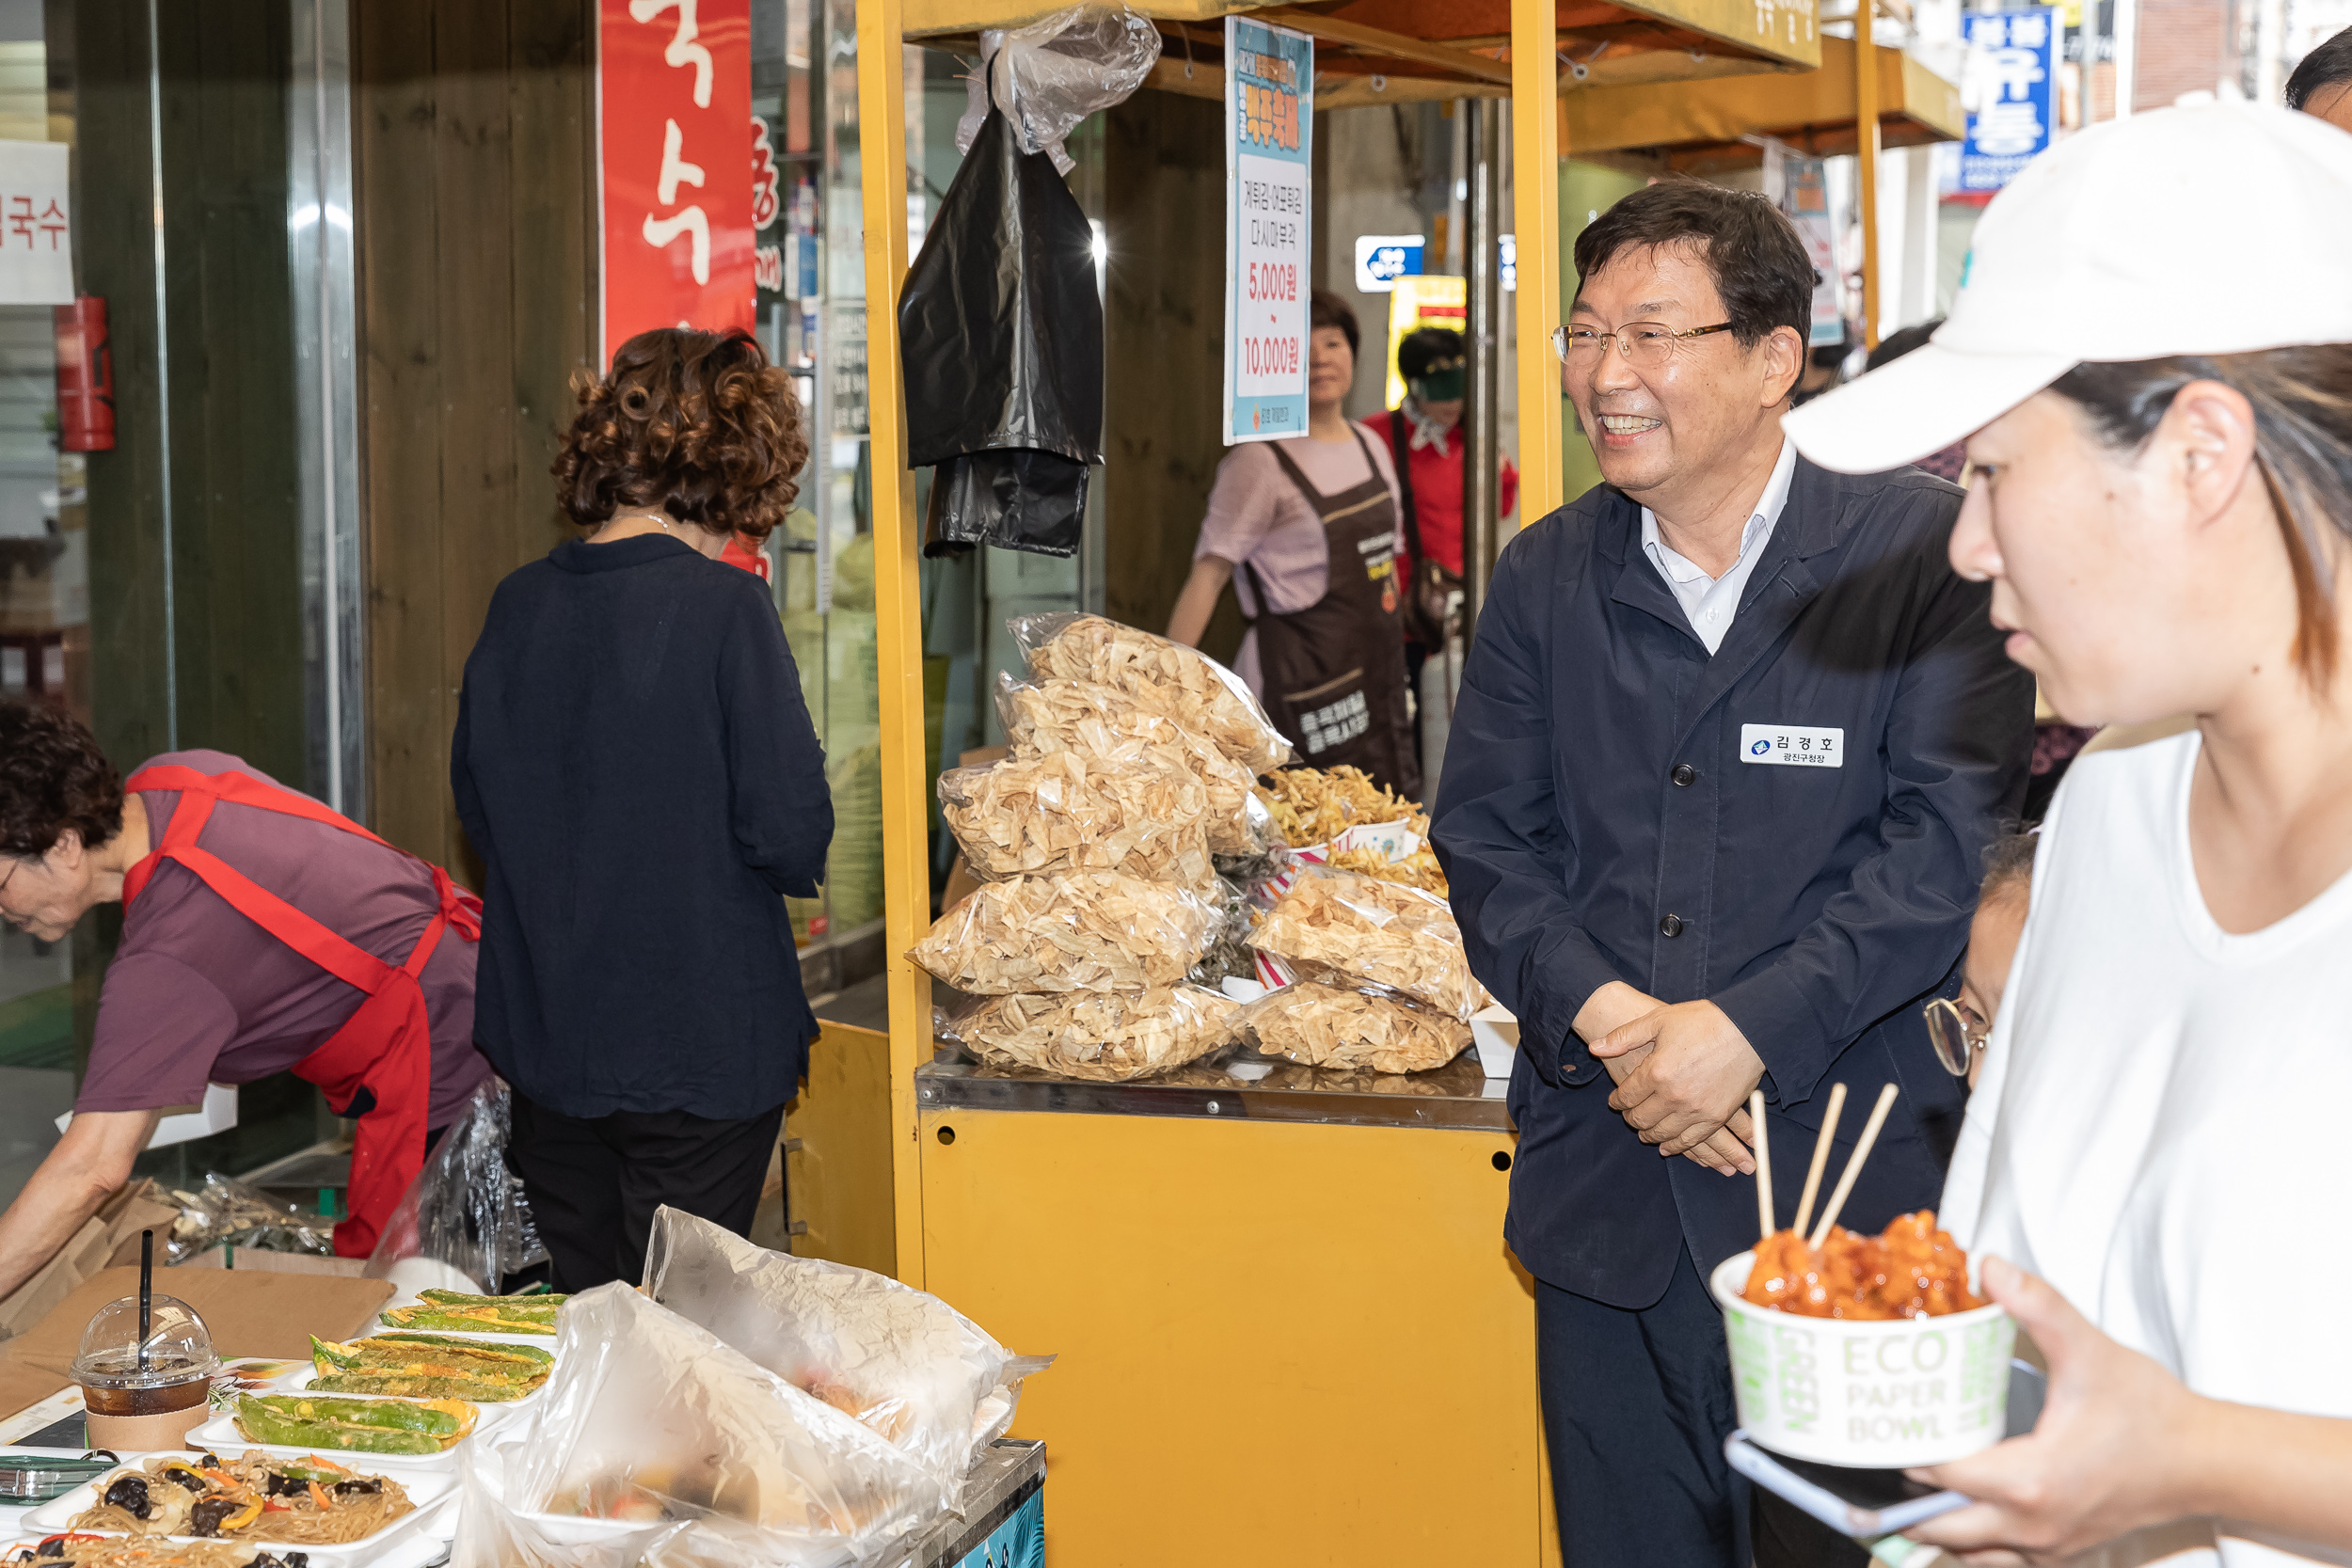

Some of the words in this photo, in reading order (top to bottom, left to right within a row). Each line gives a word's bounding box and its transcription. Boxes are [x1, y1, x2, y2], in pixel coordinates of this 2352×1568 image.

[0, 195, 67, 251] 국수
[1248, 261, 1296, 303] 5,000원
[1245, 337, 1299, 377] 10,000원
[1783, 752, 1825, 764] 광진구청장
[1843, 1329, 1948, 1377] ECO
[1846, 1379, 1947, 1409] PAPER
[1847, 1415, 1945, 1444] BOWL
